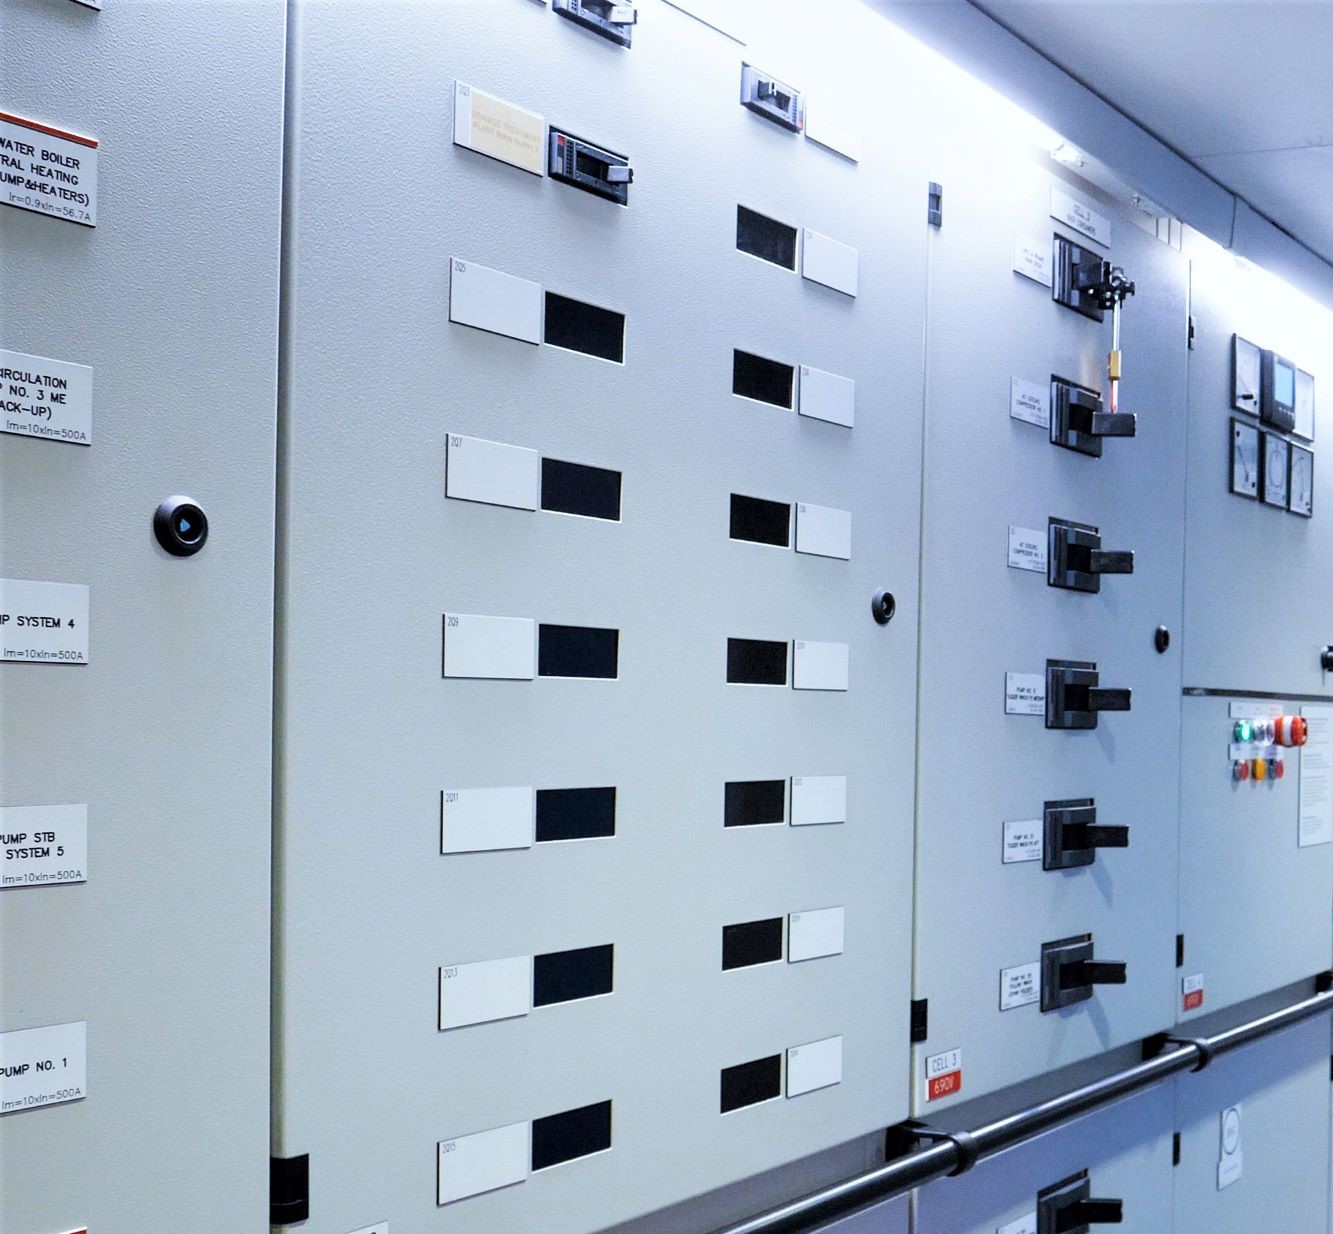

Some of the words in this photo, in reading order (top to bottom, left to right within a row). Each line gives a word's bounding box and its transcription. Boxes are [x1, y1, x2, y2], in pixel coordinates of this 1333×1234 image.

[41, 150, 80, 170] BOILER
[30, 163, 79, 186] HEATING
[9, 385, 30, 399] NO.
[37, 389, 44, 401] 3
[50, 393, 67, 405] ME
[17, 615, 61, 629] SYSTEM
[68, 619, 75, 629] 4
[34, 831, 56, 844] STB
[6, 847, 51, 860] SYSTEM
[57, 845, 65, 858] 5
[36, 1059, 56, 1073] NO.
[62, 1057, 68, 1068] 1
[932, 1055, 949, 1073] CELL
[952, 1052, 957, 1067] 3
[934, 1075, 955, 1095] 690V
